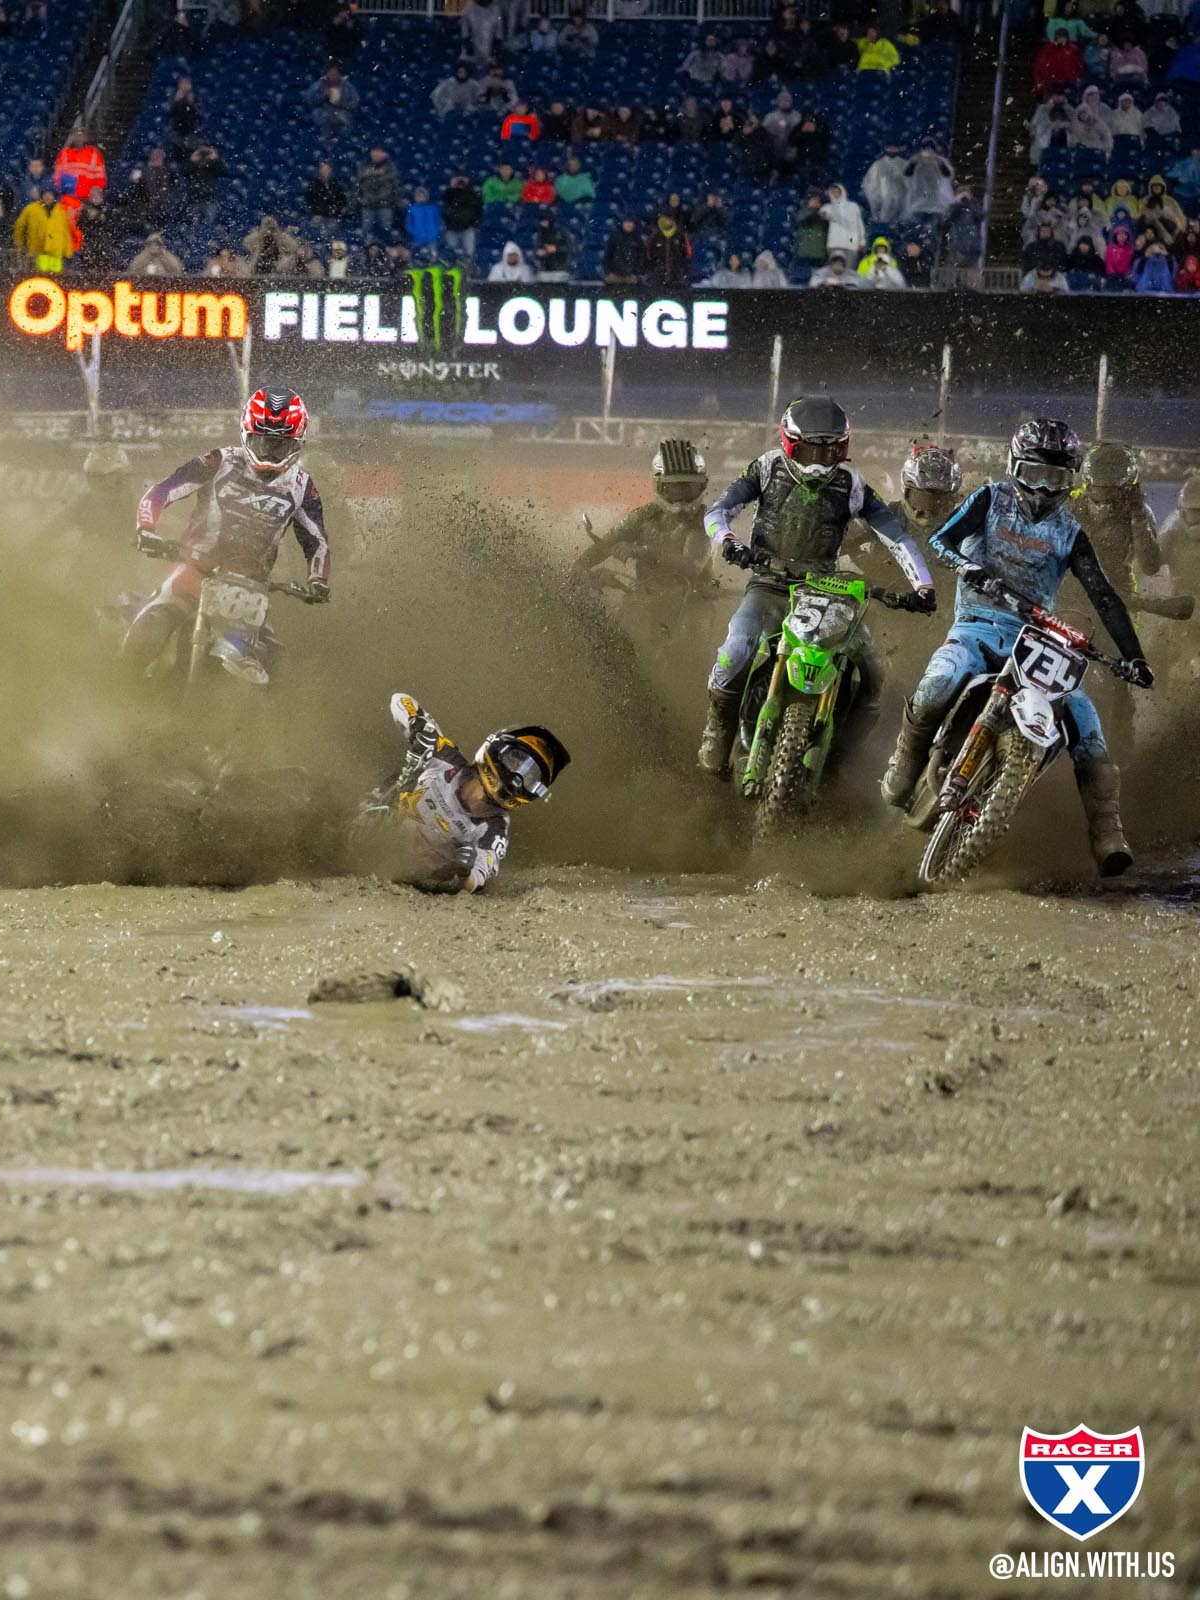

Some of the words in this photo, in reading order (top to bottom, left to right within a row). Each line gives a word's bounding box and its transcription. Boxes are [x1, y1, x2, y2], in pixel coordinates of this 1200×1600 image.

[8, 277, 248, 351] Optum
[464, 297, 729, 349] LOUNGE
[1021, 639, 1077, 692] 734
